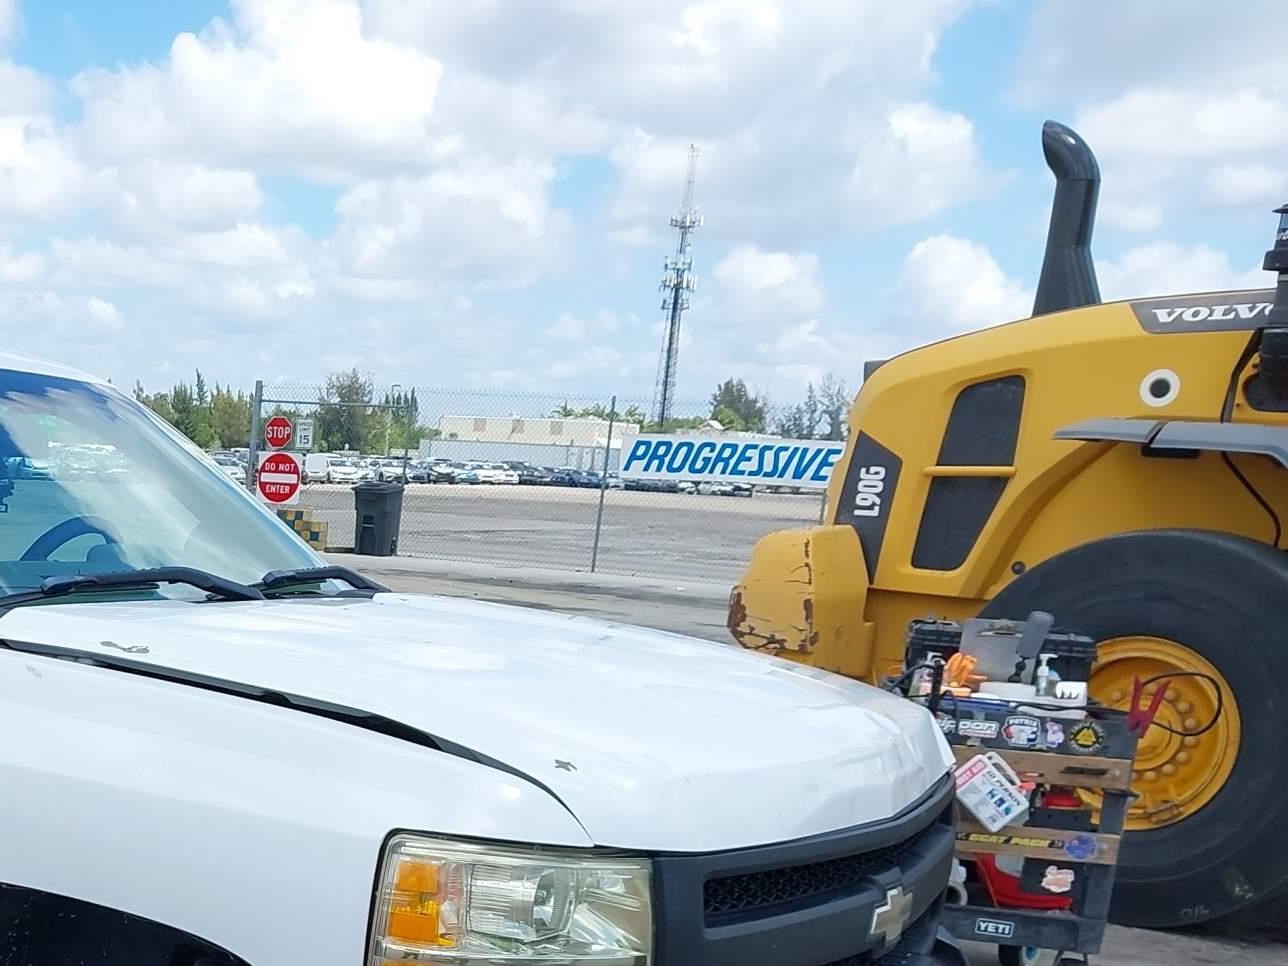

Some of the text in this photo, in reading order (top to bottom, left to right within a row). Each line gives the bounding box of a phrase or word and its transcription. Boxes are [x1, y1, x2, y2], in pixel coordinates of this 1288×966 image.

[267, 426, 291, 439] STOP
[299, 434, 310, 445] 15
[264, 462, 295, 472] DO NOT
[623, 440, 843, 482] PROGRESSIVE
[265, 484, 290, 494] ENTER
[853, 465, 886, 517] L90G
[979, 921, 1011, 935] YETI
